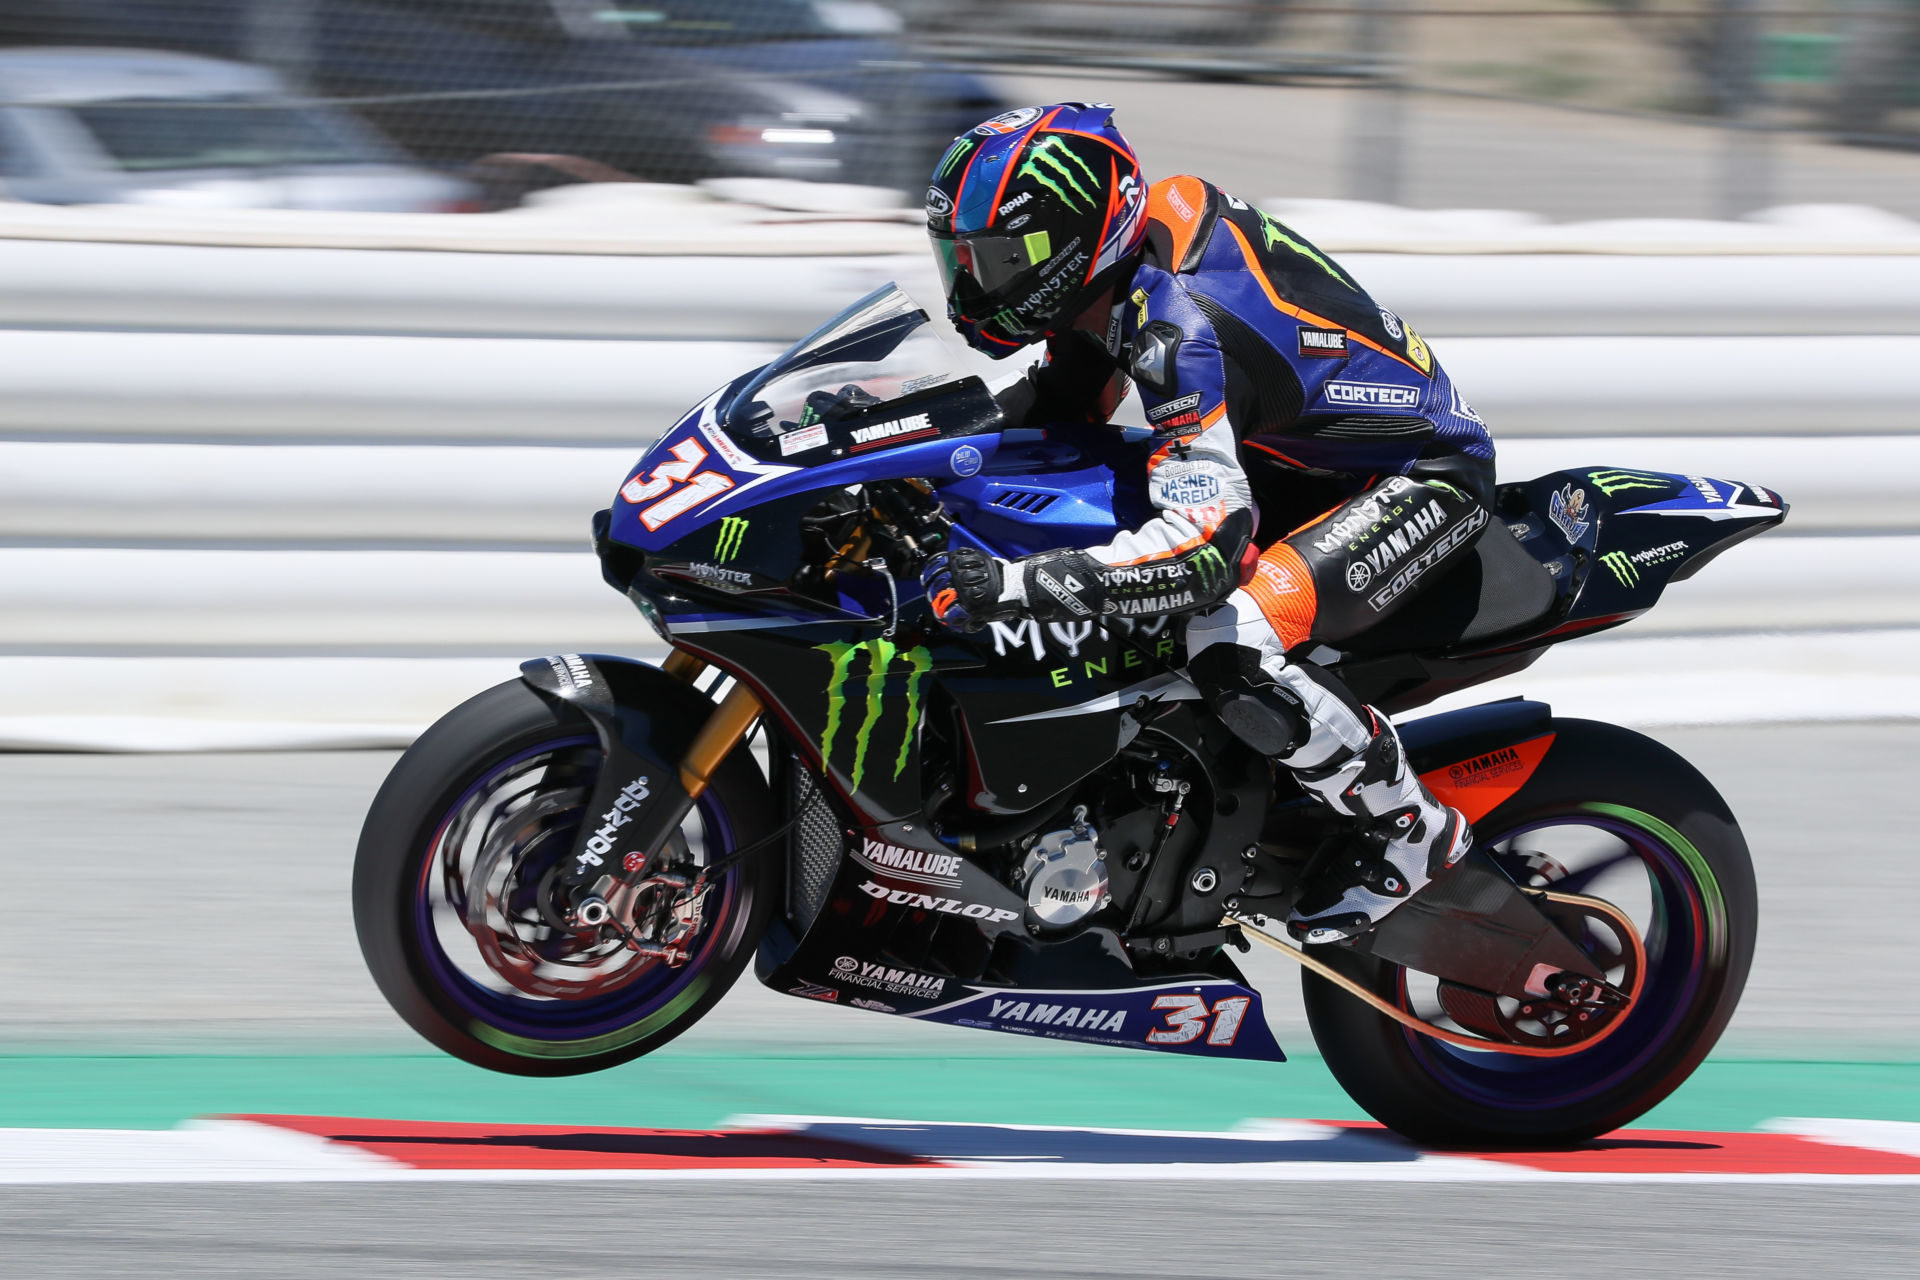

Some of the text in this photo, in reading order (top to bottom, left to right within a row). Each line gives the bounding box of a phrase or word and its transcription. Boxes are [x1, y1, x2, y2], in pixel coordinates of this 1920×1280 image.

[998, 191, 1034, 216] RPHA
[1016, 251, 1089, 315] MONSTER
[1301, 331, 1345, 348] YAMALUBE
[1151, 396, 1196, 418] CORTECH
[1327, 384, 1416, 403] CORTECH
[850, 412, 932, 443] YAMALUBE
[620, 436, 736, 532] 31
[1348, 495, 1414, 551] ENERGY
[1365, 499, 1448, 573] YAMAHA
[1375, 506, 1485, 607] CORTECH
[1631, 541, 1688, 563] MONSTER
[689, 562, 752, 585] MONSTER
[1097, 564, 1193, 587] MONSTER
[1111, 582, 1177, 594] ENERGY
[1039, 574, 1087, 614] CORTECH
[1119, 590, 1195, 615] YAMAHA
[1051, 639, 1174, 688] ENER
[1462, 748, 1519, 774] YAMAHA
[576, 780, 650, 867] DUNLOP
[862, 837, 963, 877] YAMALUBE
[858, 880, 1019, 923] DUNLOP
[1044, 886, 1090, 903] YAMAHA
[828, 968, 941, 1000] FINANCIAL SERVICES
[860, 961, 946, 991] YAMAHA
[987, 999, 1127, 1032] YAMAHA
[1146, 994, 1250, 1046] 31
